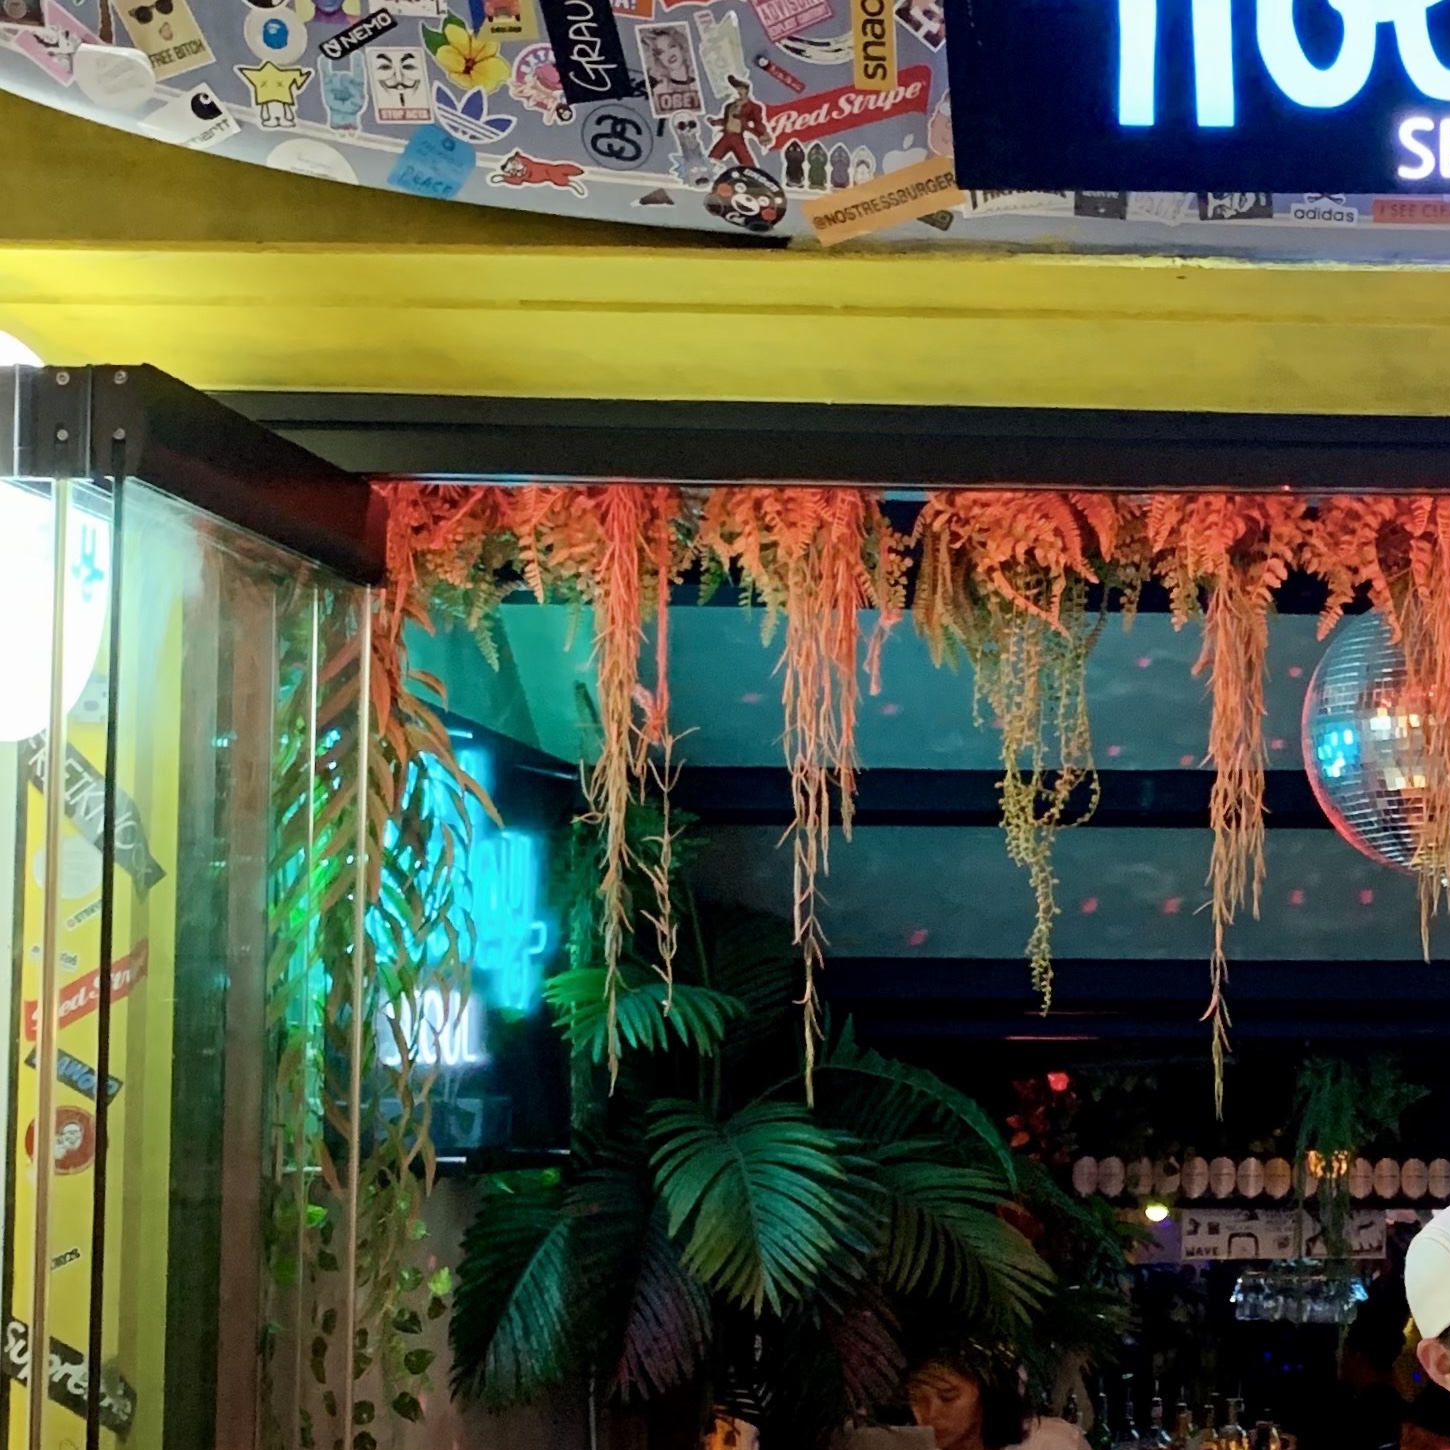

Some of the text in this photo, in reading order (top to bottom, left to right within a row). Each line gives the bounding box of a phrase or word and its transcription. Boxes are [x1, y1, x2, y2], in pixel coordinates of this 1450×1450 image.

[340, 12, 393, 50] NEMO
[771, 80, 924, 139] Red Stripe
[1293, 206, 1355, 224] adidas
[1390, 203, 1416, 218] SEE
[5, 1321, 132, 1422] Supree
